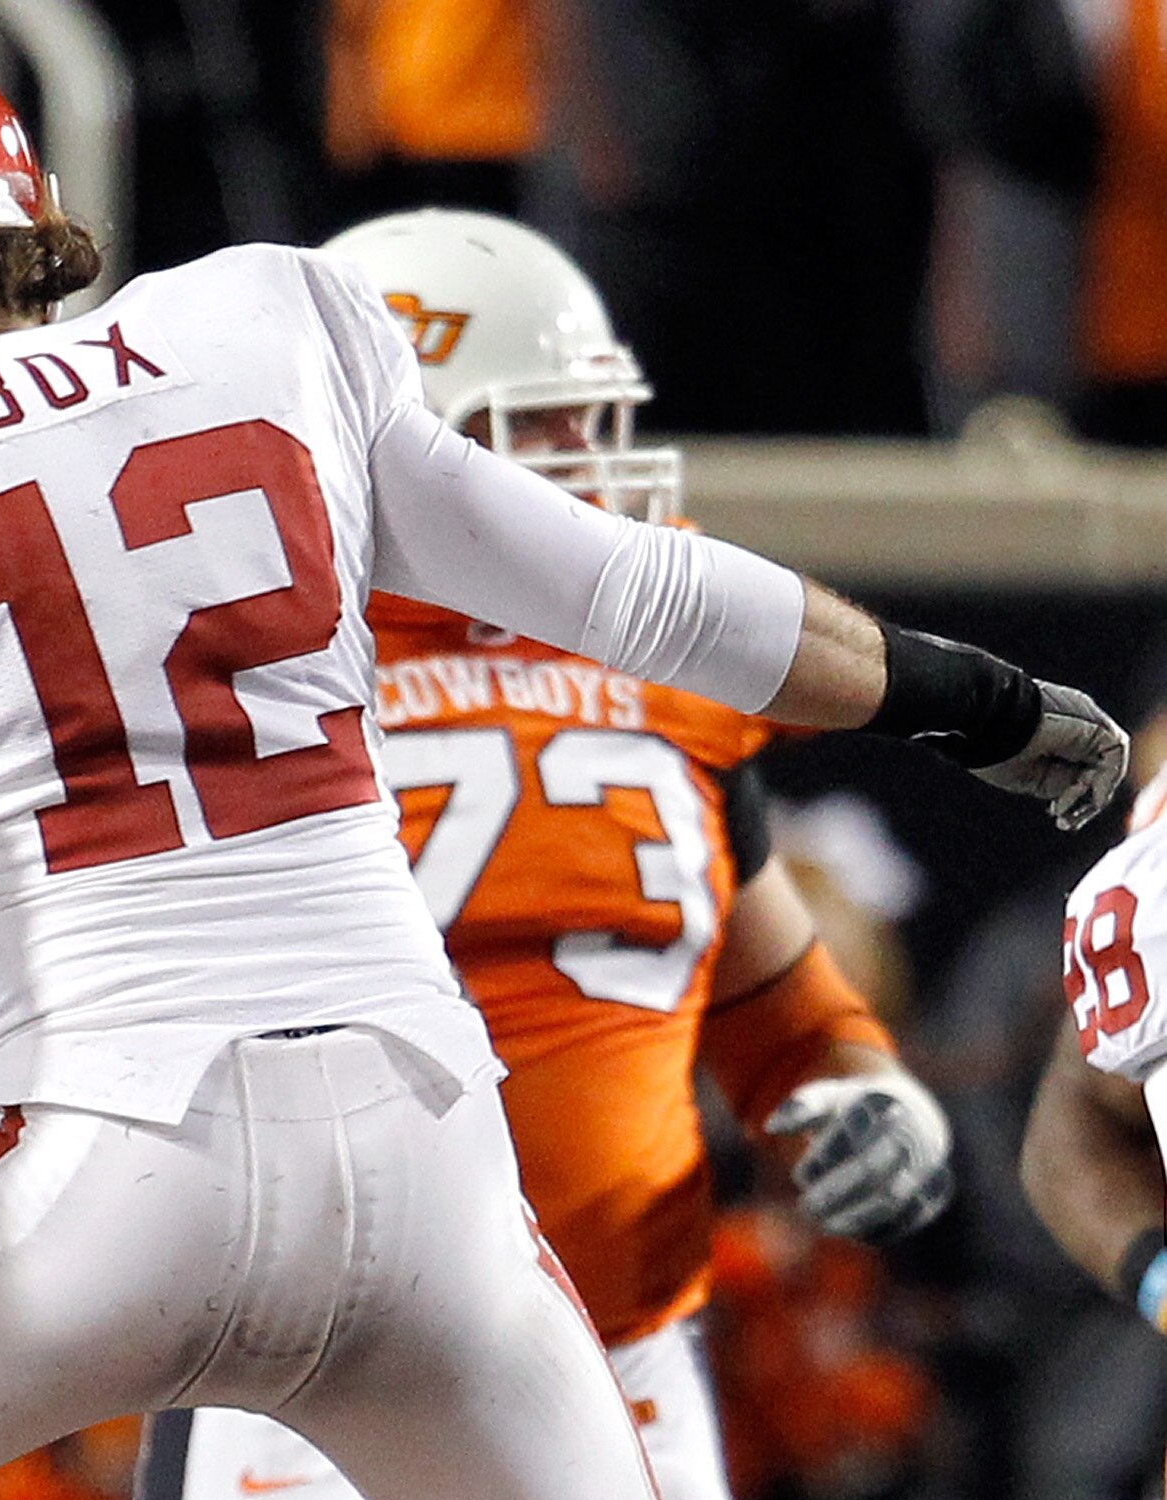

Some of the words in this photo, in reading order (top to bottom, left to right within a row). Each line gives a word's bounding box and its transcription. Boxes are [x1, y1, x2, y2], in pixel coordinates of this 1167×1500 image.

[375, 654, 646, 730] COWBOYS
[382, 727, 718, 1014] 73
[1063, 884, 1151, 1058] 28
